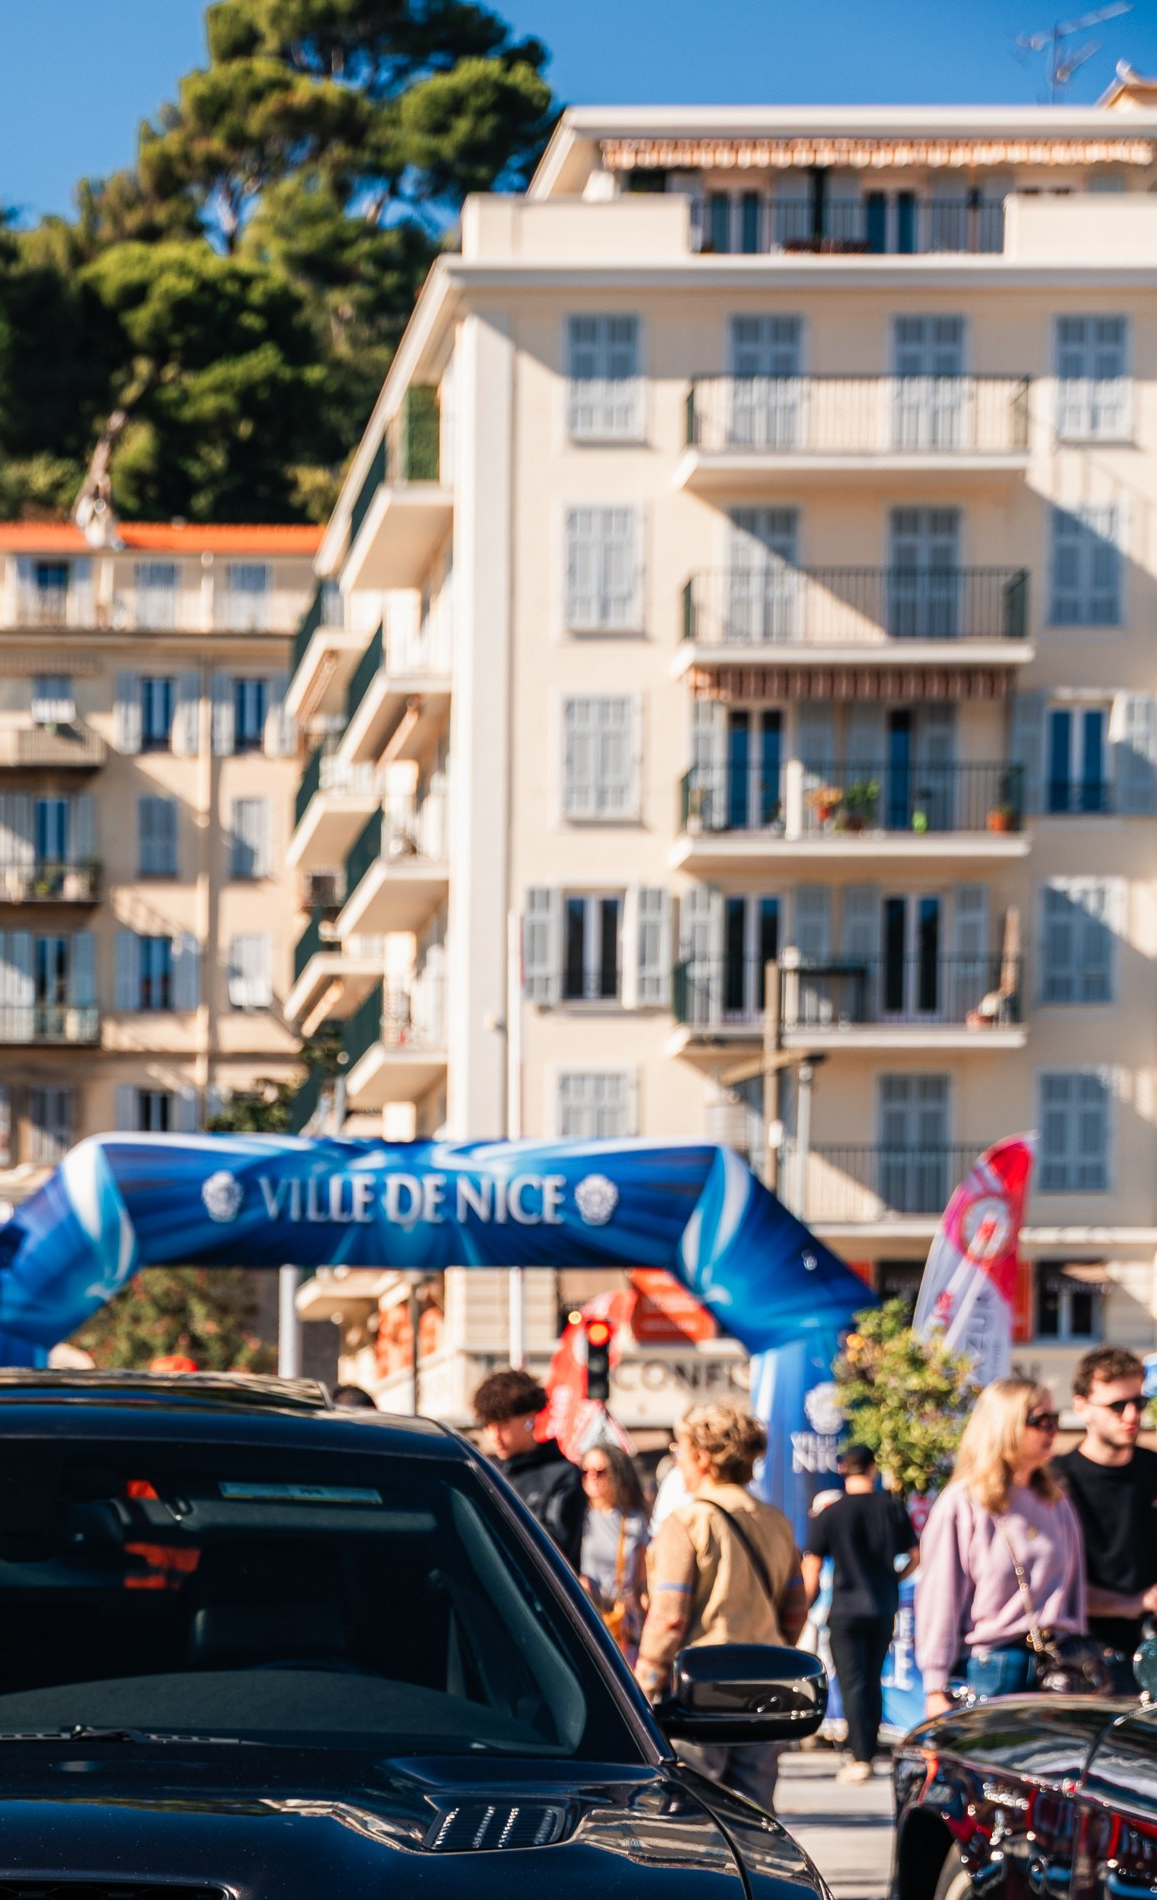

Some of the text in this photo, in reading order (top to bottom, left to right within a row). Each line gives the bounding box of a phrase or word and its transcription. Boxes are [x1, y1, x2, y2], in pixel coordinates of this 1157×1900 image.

[258, 1173, 566, 1226] VILLE DE NICE
[792, 1449, 839, 1474] NIC
